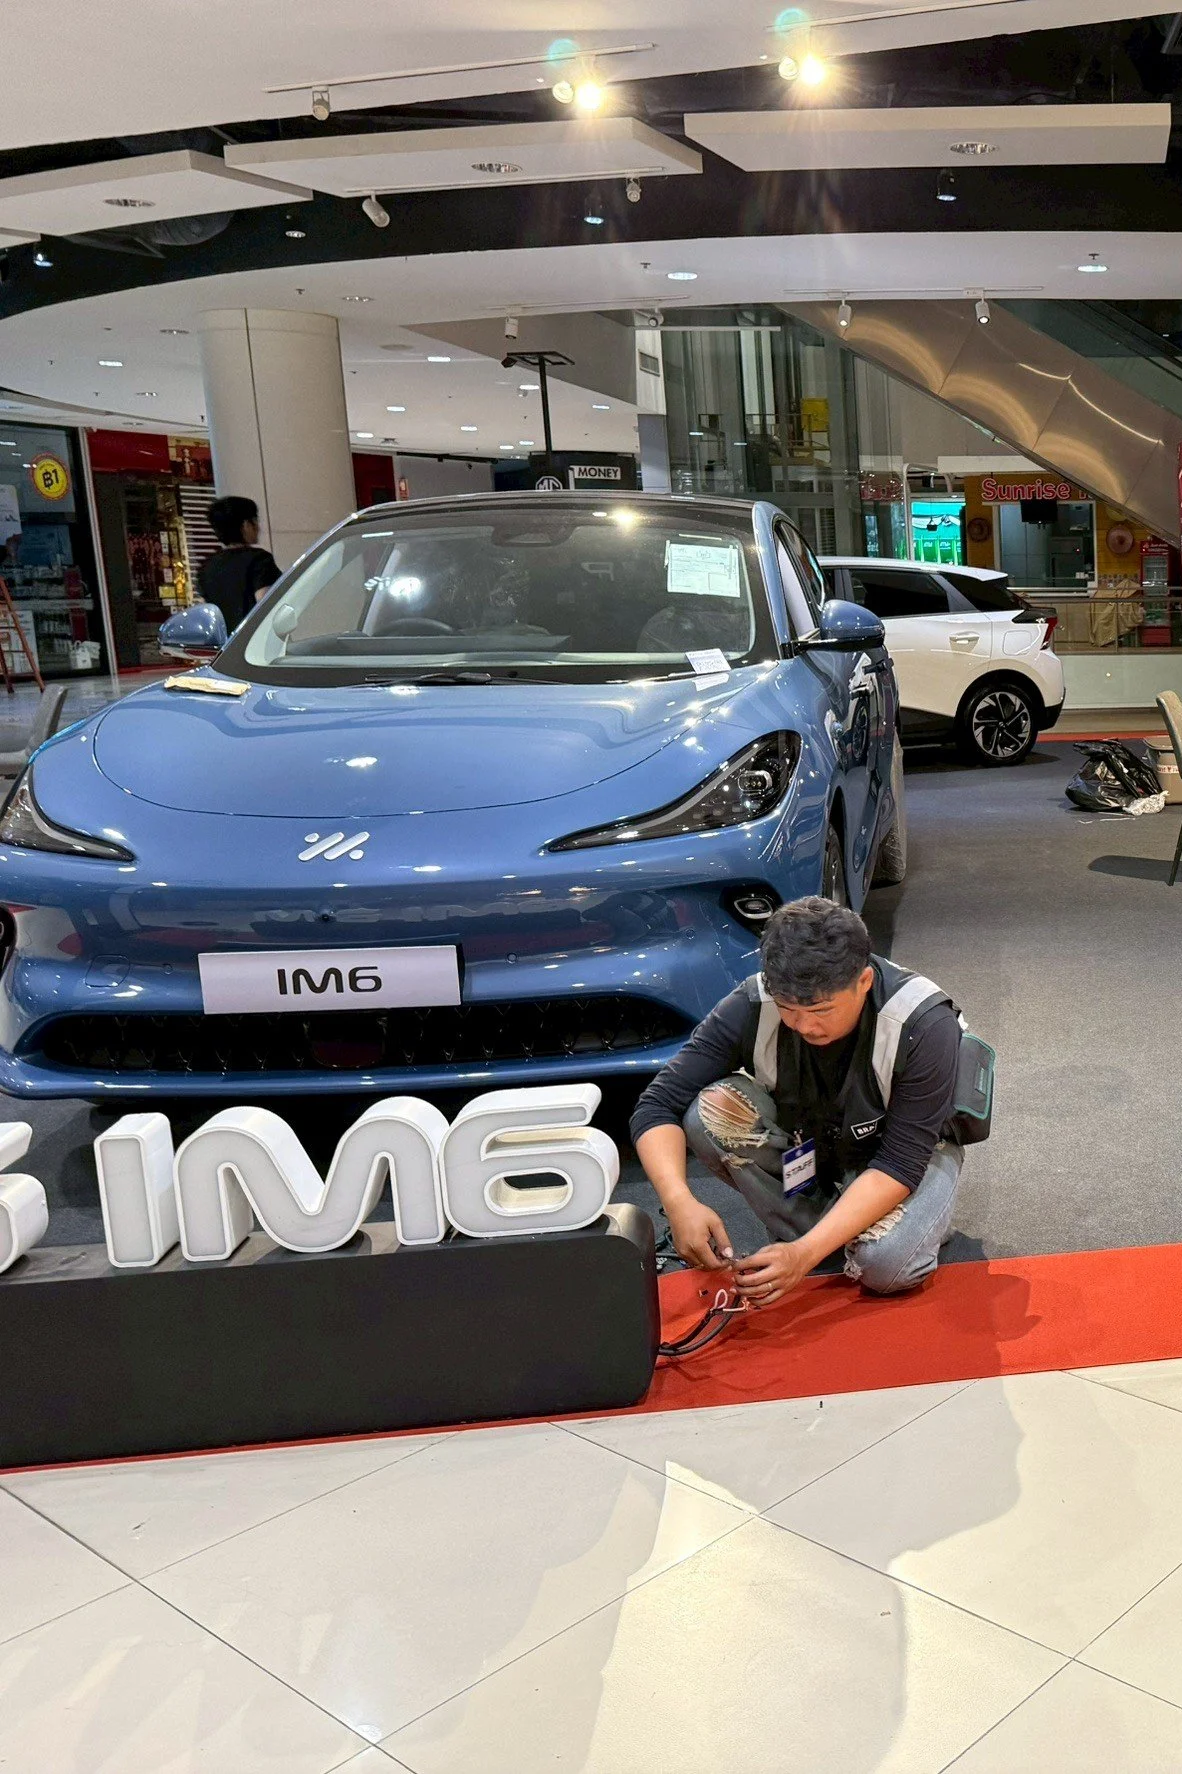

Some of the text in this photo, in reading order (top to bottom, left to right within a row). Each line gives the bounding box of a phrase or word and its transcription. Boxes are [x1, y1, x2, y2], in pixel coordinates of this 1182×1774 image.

[577, 467, 619, 478] MONEY
[982, 478, 1071, 500] Sunrise
[277, 966, 382, 995] IM6
[95, 1083, 620, 1267] IM6
[785, 1158, 813, 1179] STAFF
